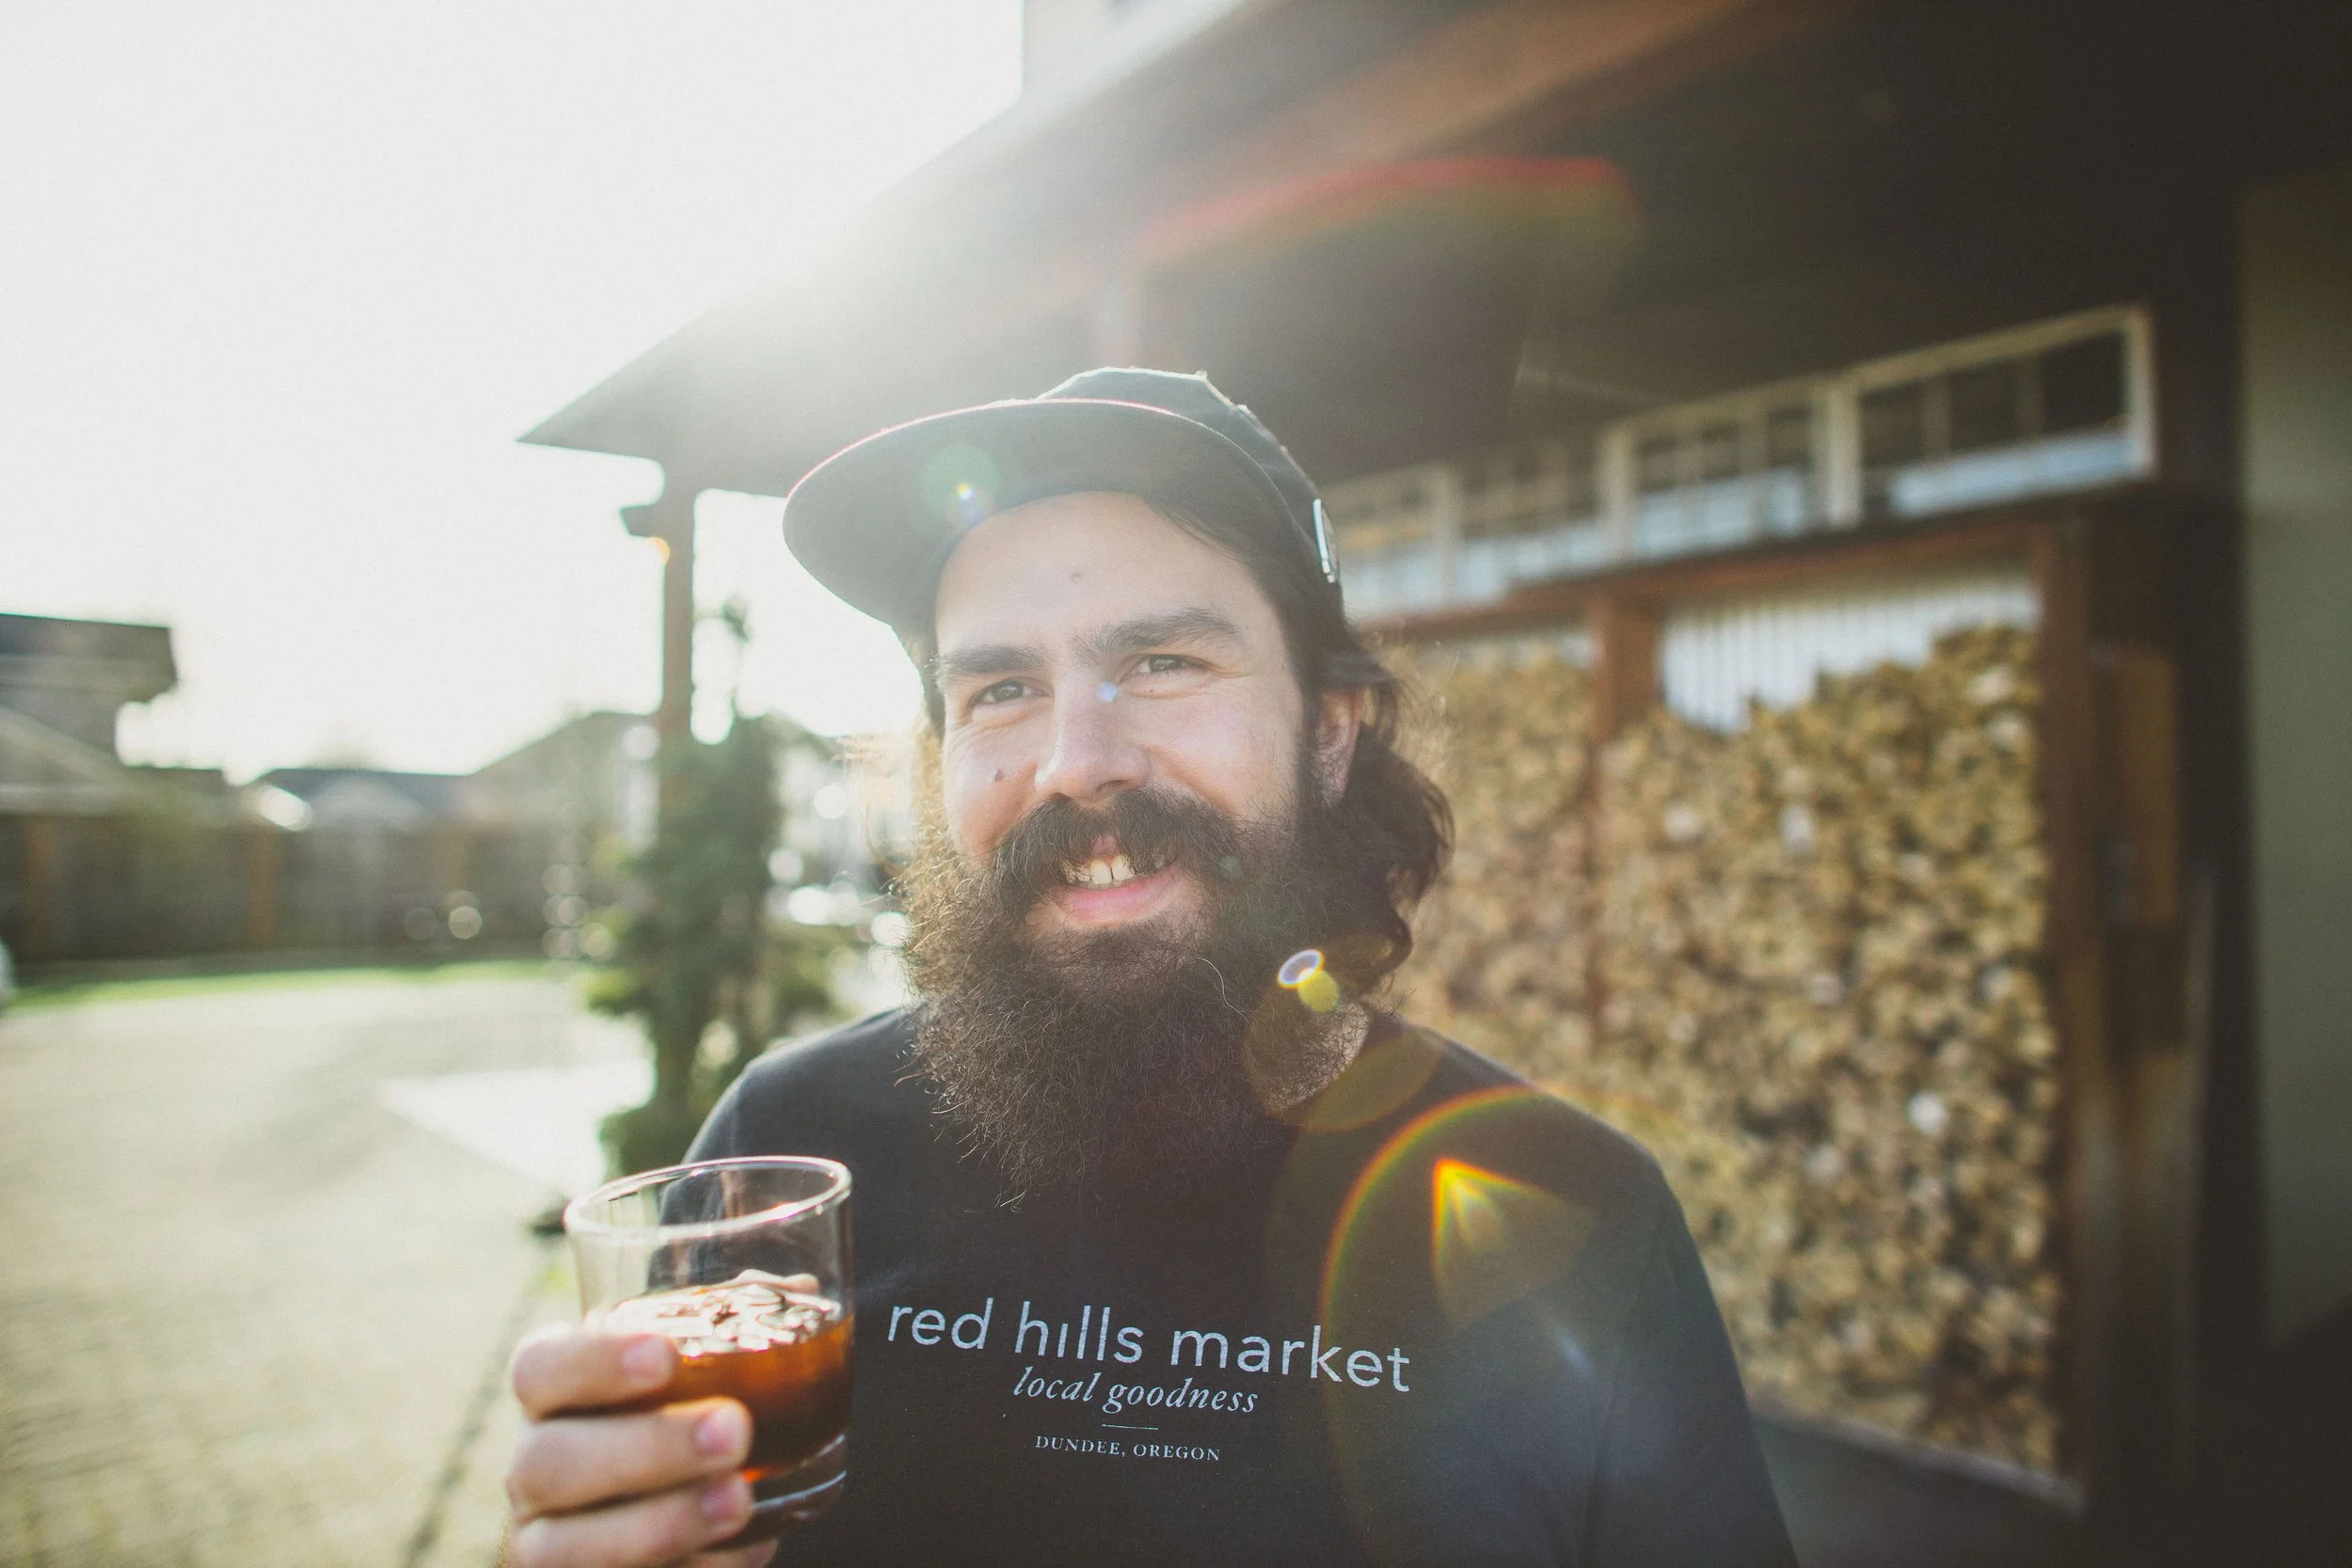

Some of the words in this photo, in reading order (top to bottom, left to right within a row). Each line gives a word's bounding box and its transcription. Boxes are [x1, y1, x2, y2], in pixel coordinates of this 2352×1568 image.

[887, 1297, 993, 1351] red
[1170, 1324, 1411, 1392] market
[1012, 1366, 1102, 1402] local
[1102, 1377, 1259, 1414] goodness
[1035, 1435, 1126, 1457] DUNDEE,
[1133, 1443, 1221, 1462] OREGON
